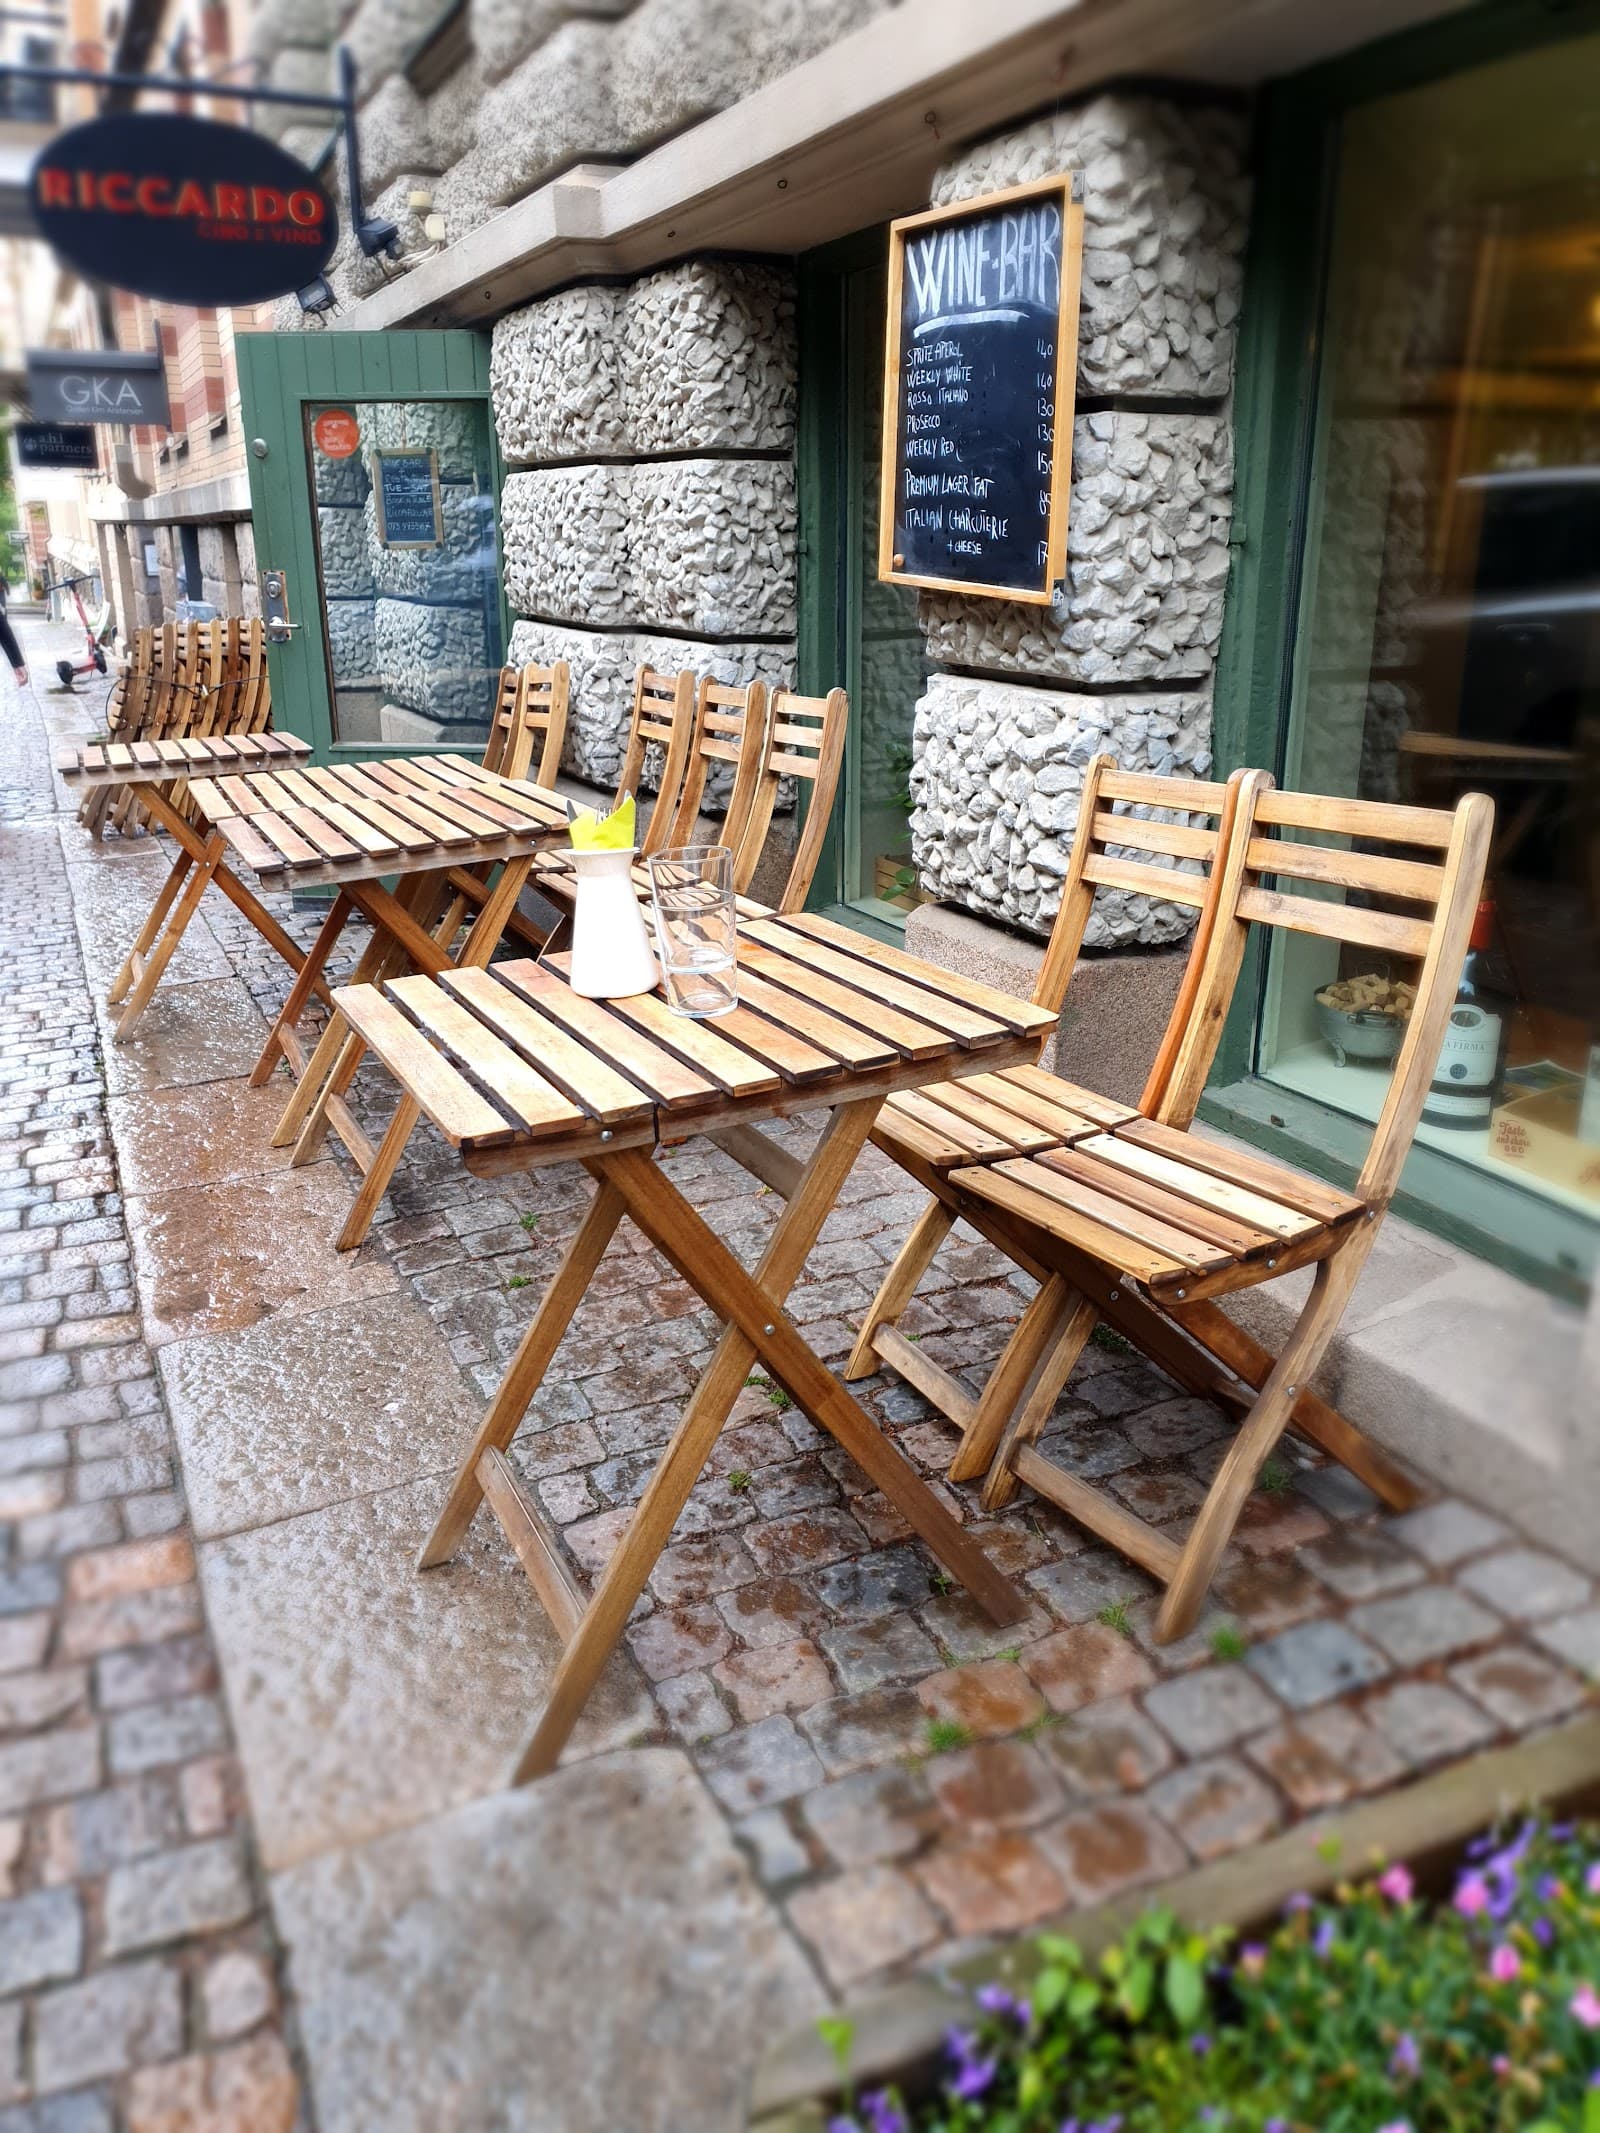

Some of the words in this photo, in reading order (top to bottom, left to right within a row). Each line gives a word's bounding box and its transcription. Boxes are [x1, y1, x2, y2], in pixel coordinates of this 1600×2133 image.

[37, 167, 326, 226] RICCARDO
[1036, 340, 1053, 359] 140
[906, 368, 941, 388] WEEKLY
[945, 362, 973, 383] WHITE
[1036, 373, 1053, 391] 140
[59, 375, 143, 408] GKA
[907, 391, 932, 410] ROSSO
[938, 387, 969, 405] ITALIANO
[1036, 399, 1054, 417] 130
[906, 414, 941, 435] PROSECCO
[1036, 425, 1055, 443] 130
[40, 442, 93, 456] partners
[905, 438, 938, 460] WEEKLY
[940, 436, 955, 457] RED
[384, 483, 402, 493] TUE
[904, 468, 940, 499] PREMIUM
[941, 472, 970, 497] LAGER
[972, 475, 995, 499] FAT
[905, 503, 943, 530] ITALIAN
[948, 507, 1009, 540] CHARCUTERIE
[954, 540, 983, 556] CHEESE
[1452, 1041, 1485, 1052] FIRMA
